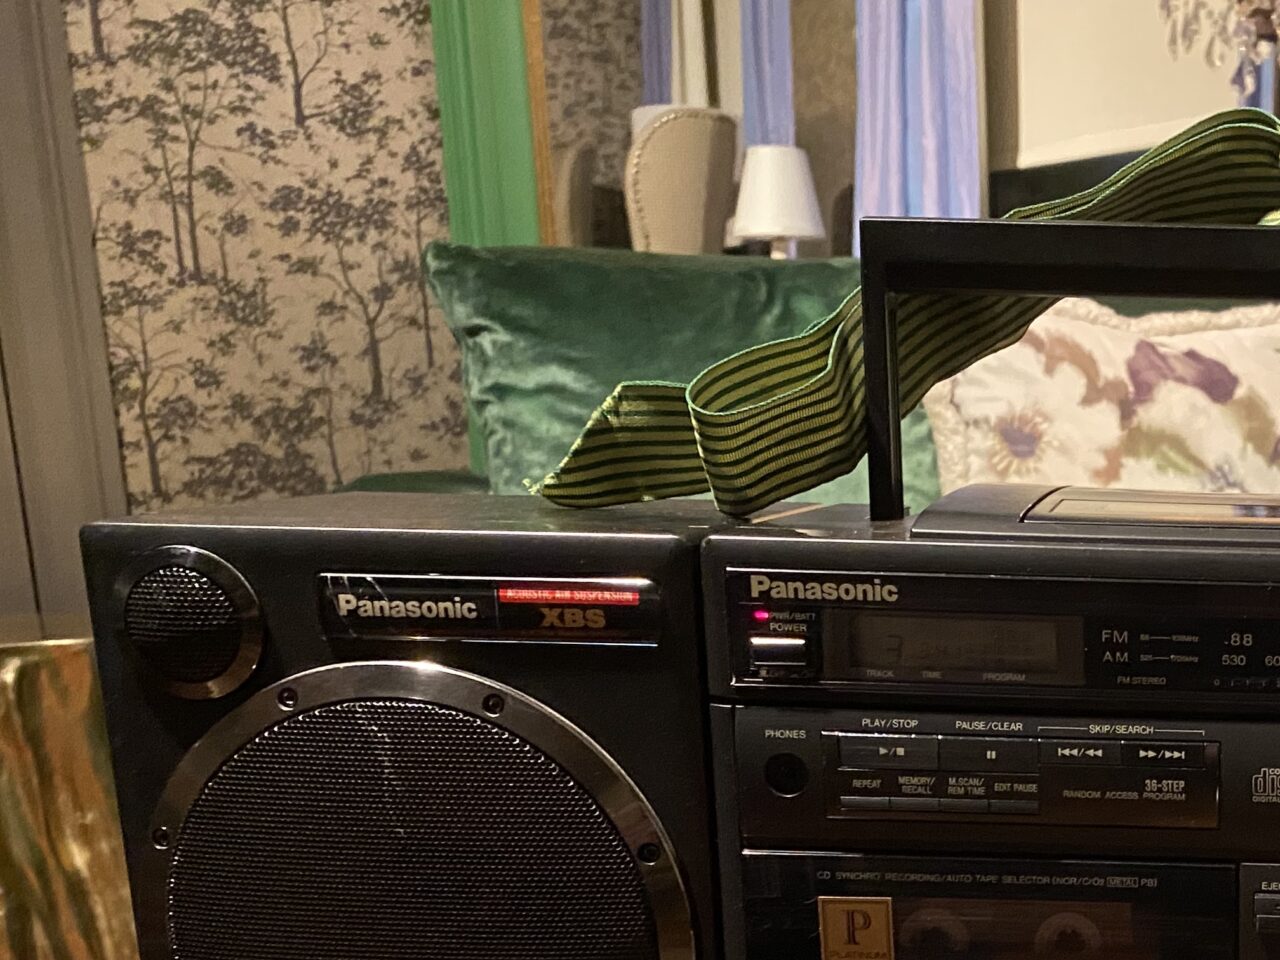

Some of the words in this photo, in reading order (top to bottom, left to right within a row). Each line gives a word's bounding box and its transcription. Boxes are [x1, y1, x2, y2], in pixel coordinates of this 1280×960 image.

[751, 575, 899, 602] Panasonic
[338, 593, 478, 620] Panasonic
[540, 607, 606, 629] XBS
[769, 622, 807, 632] POWER
[1102, 630, 1128, 644] FM
[1103, 651, 1128, 663] AM
[1222, 654, 1247, 666] 530
[866, 669, 895, 678] TRACK
[922, 670, 944, 679] TIME
[983, 672, 1026, 681] PROGRAM
[1131, 677, 1167, 686] STEREO
[861, 718, 919, 729] PLAY/STOP
[955, 720, 1023, 732] PAUSE/CLEAR
[764, 729, 806, 740] PHONES
[1088, 724, 1154, 736] SKIP/SEARCH
[852, 779, 882, 789] REPEAT
[898, 776, 935, 786] MEMORY/
[1144, 779, 1185, 792] 36-STEP
[901, 785, 932, 795] RECALL
[967, 786, 986, 796] TIME
[994, 782, 1012, 792] EDIT
[1013, 783, 1039, 793] PAUSE
[1063, 789, 1101, 799] RANDOM
[1105, 791, 1139, 800] ACCESS
[1143, 792, 1186, 801] PROGRAM
[816, 872, 831, 880] CD
[835, 872, 881, 880] SYNCHRO
[885, 872, 972, 882] RECORDING/AUTO
[976, 874, 999, 883] TAPE
[1001, 874, 1051, 884] SELECTOR
[840, 909, 872, 946] P
